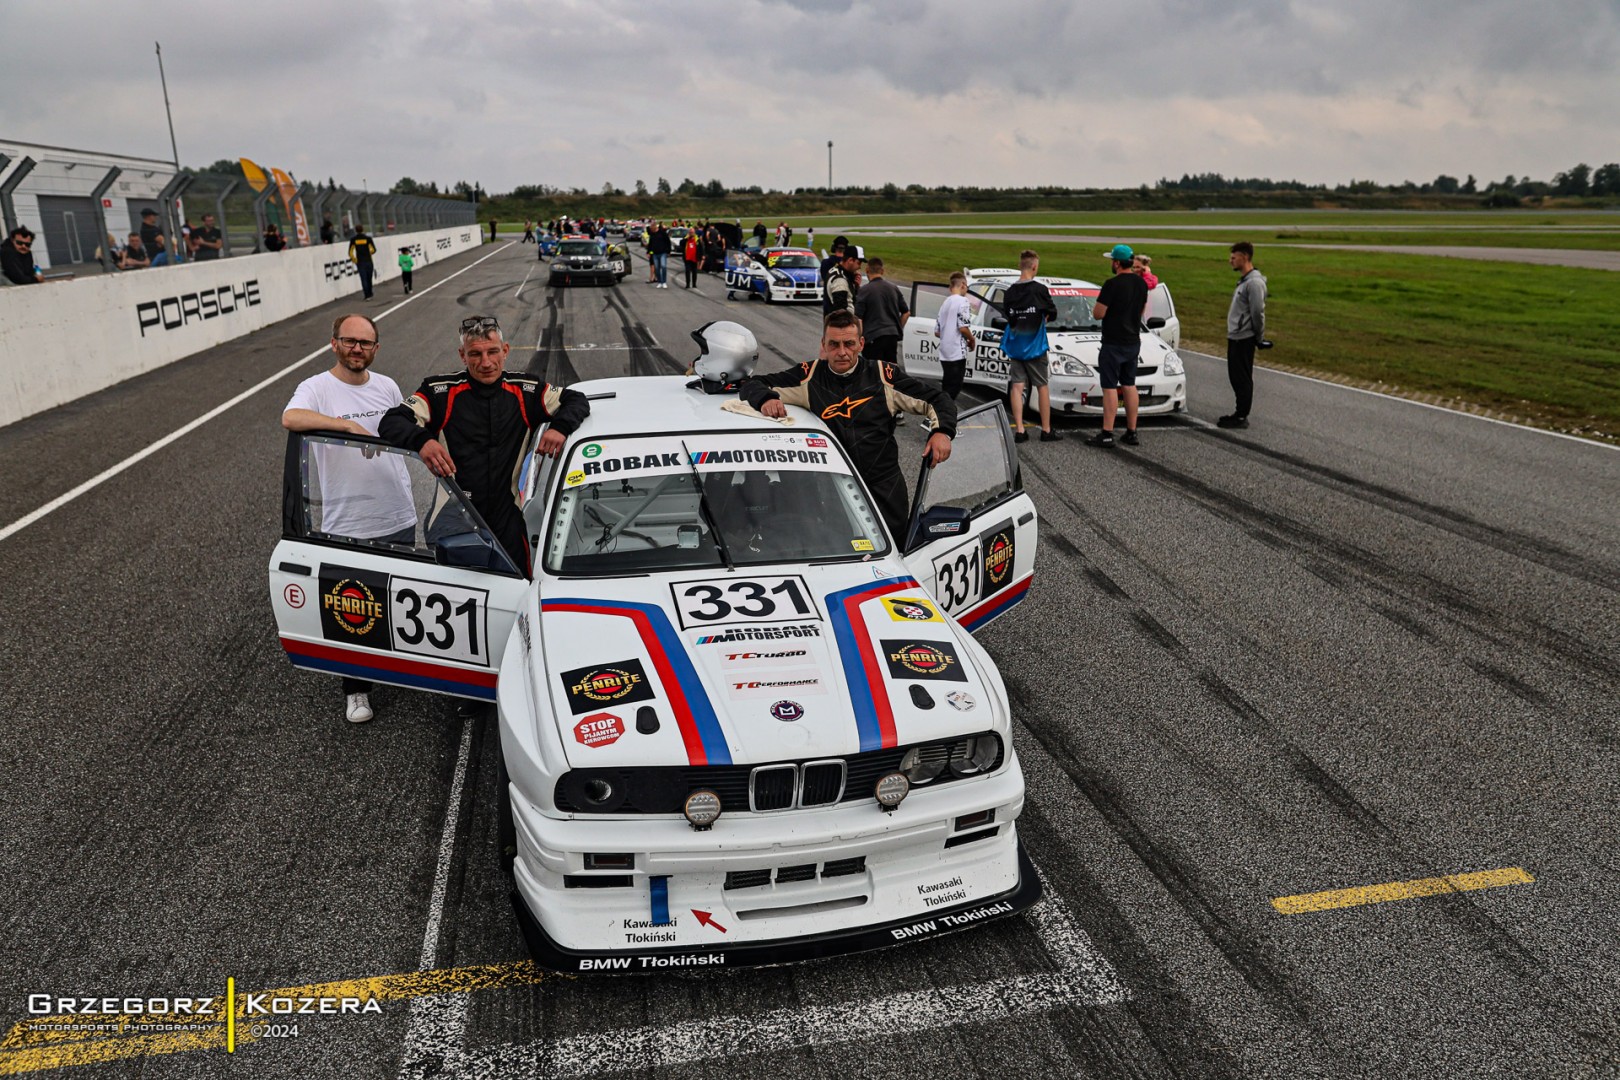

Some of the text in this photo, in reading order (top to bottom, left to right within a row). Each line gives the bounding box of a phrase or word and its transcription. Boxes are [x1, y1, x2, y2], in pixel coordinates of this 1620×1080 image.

[136, 279, 261, 337] PORSCHE
[352, 409, 387, 418] RACIN
[582, 449, 828, 475] ROBAK MOTORSPORT
[985, 543, 1014, 571] PENRITE
[938, 545, 980, 613] 331
[289, 588, 300, 603] E
[684, 579, 811, 621] 331
[324, 593, 383, 619] PENRITE
[395, 588, 480, 656] 331
[711, 628, 820, 643] MOTORSPORT
[891, 652, 954, 664] PENRITE
[571, 673, 641, 695] PENRITE
[579, 718, 616, 734] STOP
[583, 727, 617, 739] PIJANYM
[917, 876, 963, 895] Kawasaki
[922, 889, 967, 907] Tłokiński
[891, 901, 1014, 940] BMW Tłokiński
[625, 931, 676, 943] Tłokiński
[579, 953, 725, 970] BMW Tłokiński
